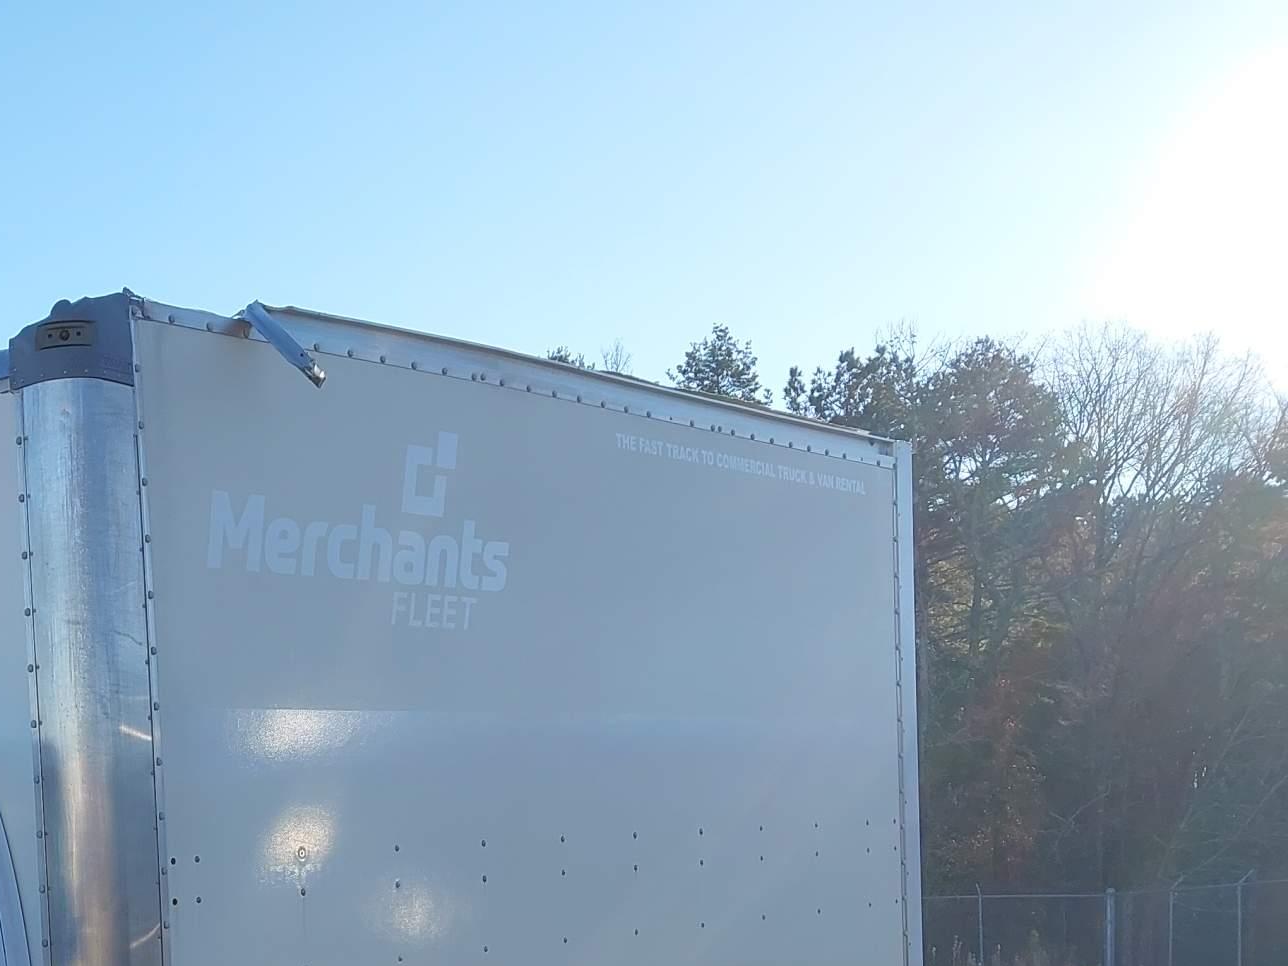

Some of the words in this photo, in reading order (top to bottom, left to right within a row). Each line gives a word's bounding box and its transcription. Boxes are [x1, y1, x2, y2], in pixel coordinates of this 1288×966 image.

[615, 432, 638, 452] THE
[639, 437, 663, 457] FAST
[665, 443, 699, 464] TRACK
[701, 449, 715, 465] TO
[716, 452, 775, 477] COMMERCIAL
[777, 464, 808, 484] TRUCK
[817, 472, 835, 489] VAN
[835, 476, 867, 495] RENTAL
[207, 489, 510, 592] Merchants
[391, 591, 478, 630] FLEET
